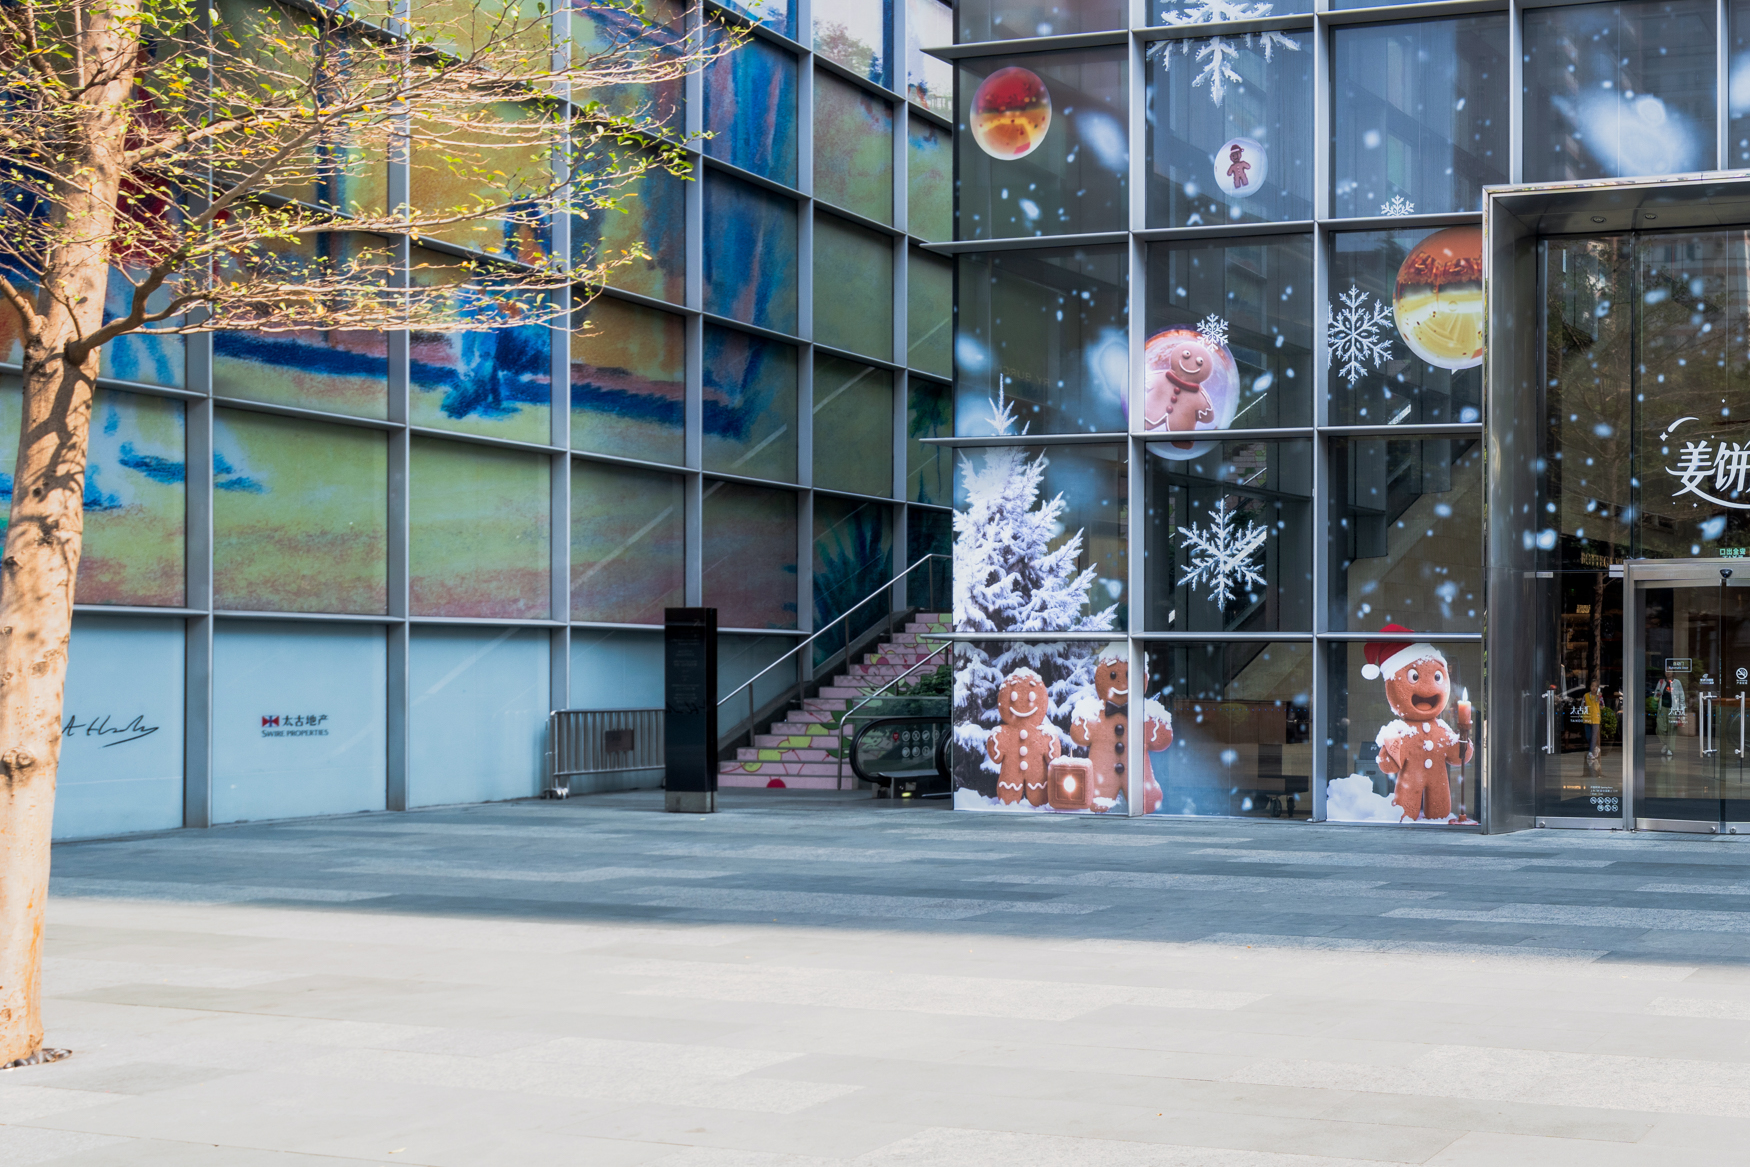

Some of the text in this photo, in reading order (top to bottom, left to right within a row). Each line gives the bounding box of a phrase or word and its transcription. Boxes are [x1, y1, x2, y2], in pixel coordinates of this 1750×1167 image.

[282, 714, 329, 726] 太古地产
[261, 728, 329, 738] SWIRE PROPERTIES
